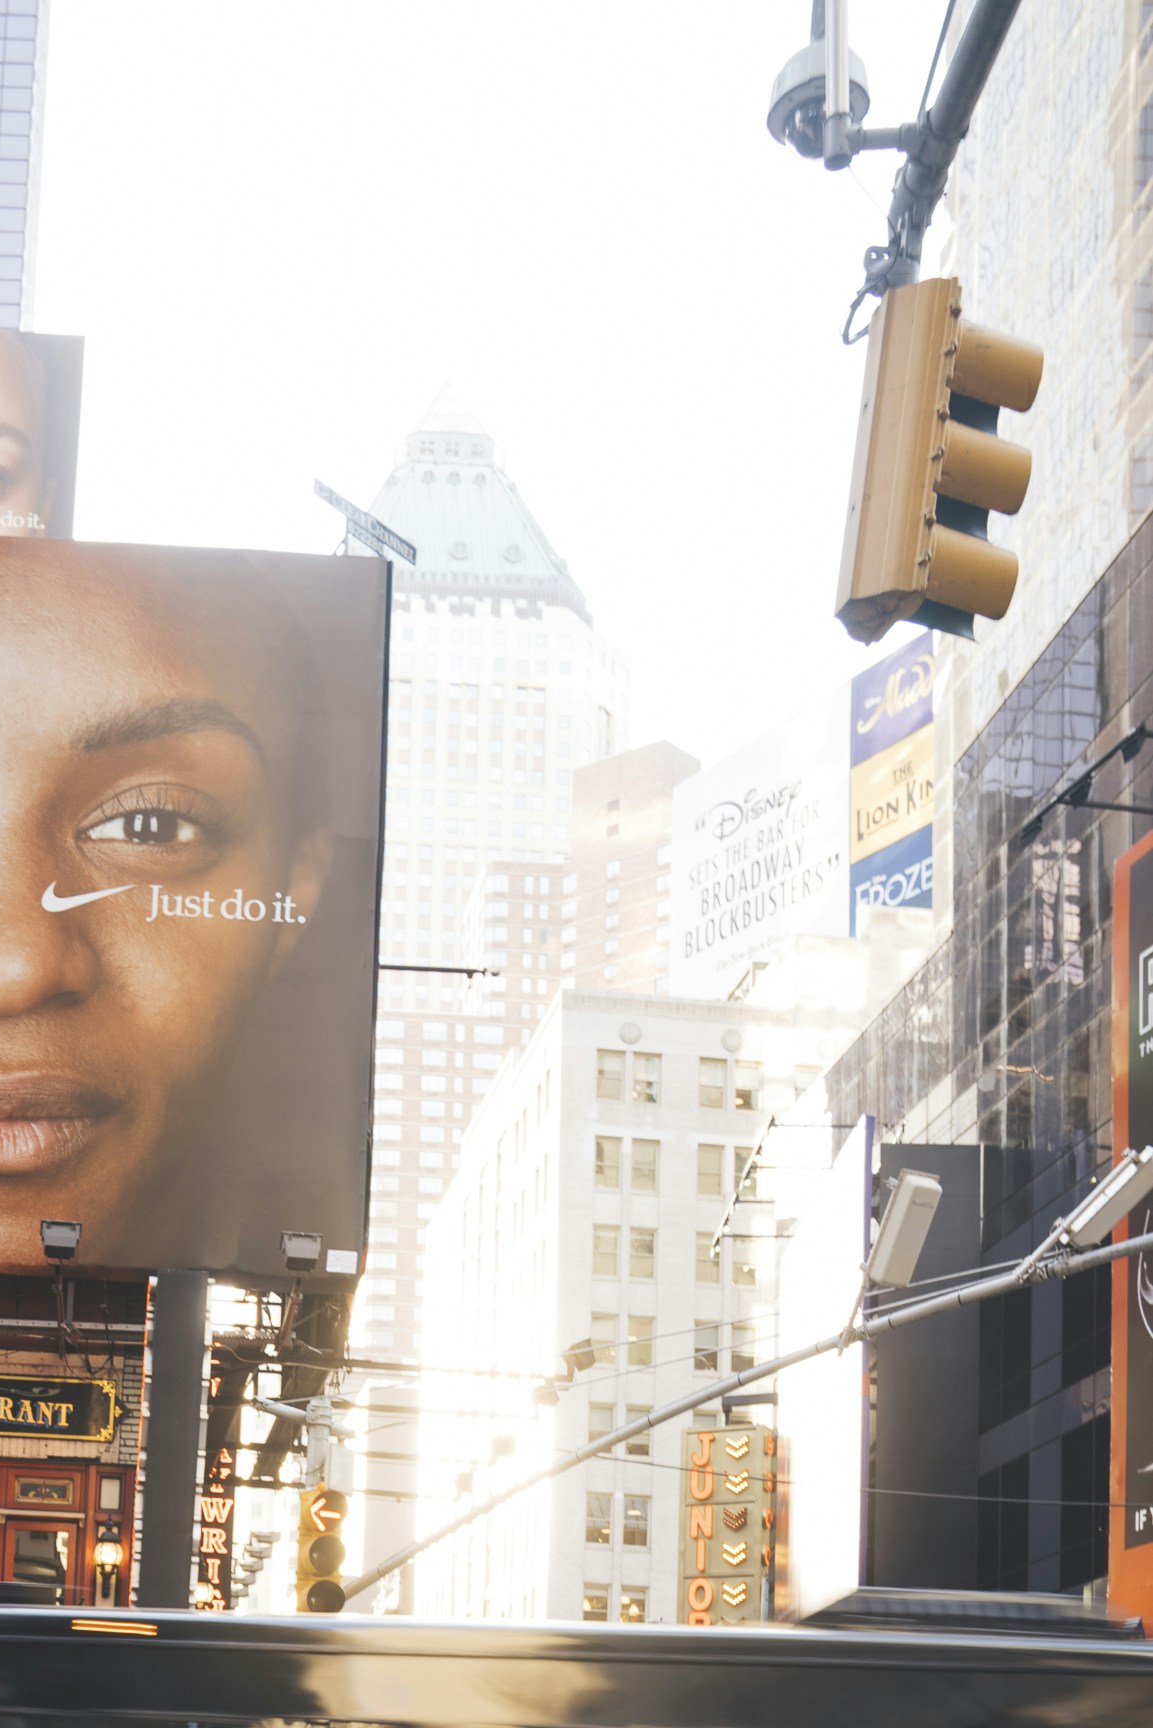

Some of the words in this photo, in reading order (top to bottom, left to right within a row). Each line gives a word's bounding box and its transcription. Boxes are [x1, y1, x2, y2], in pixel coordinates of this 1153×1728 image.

[1, 511, 24, 529] do
[27, 512, 46, 530] it.
[367, 514, 414, 561] CHANNEL
[893, 763, 914, 786] THE
[857, 796, 899, 842] LION
[689, 853, 718, 891] SETS
[724, 836, 751, 870] THE
[757, 818, 784, 853] BAR
[701, 837, 805, 917] BROADWAY
[145, 883, 214, 924] Just
[219, 889, 266, 923] do
[271, 893, 306, 925] it.
[1135, 1508, 1147, 1532] IF
